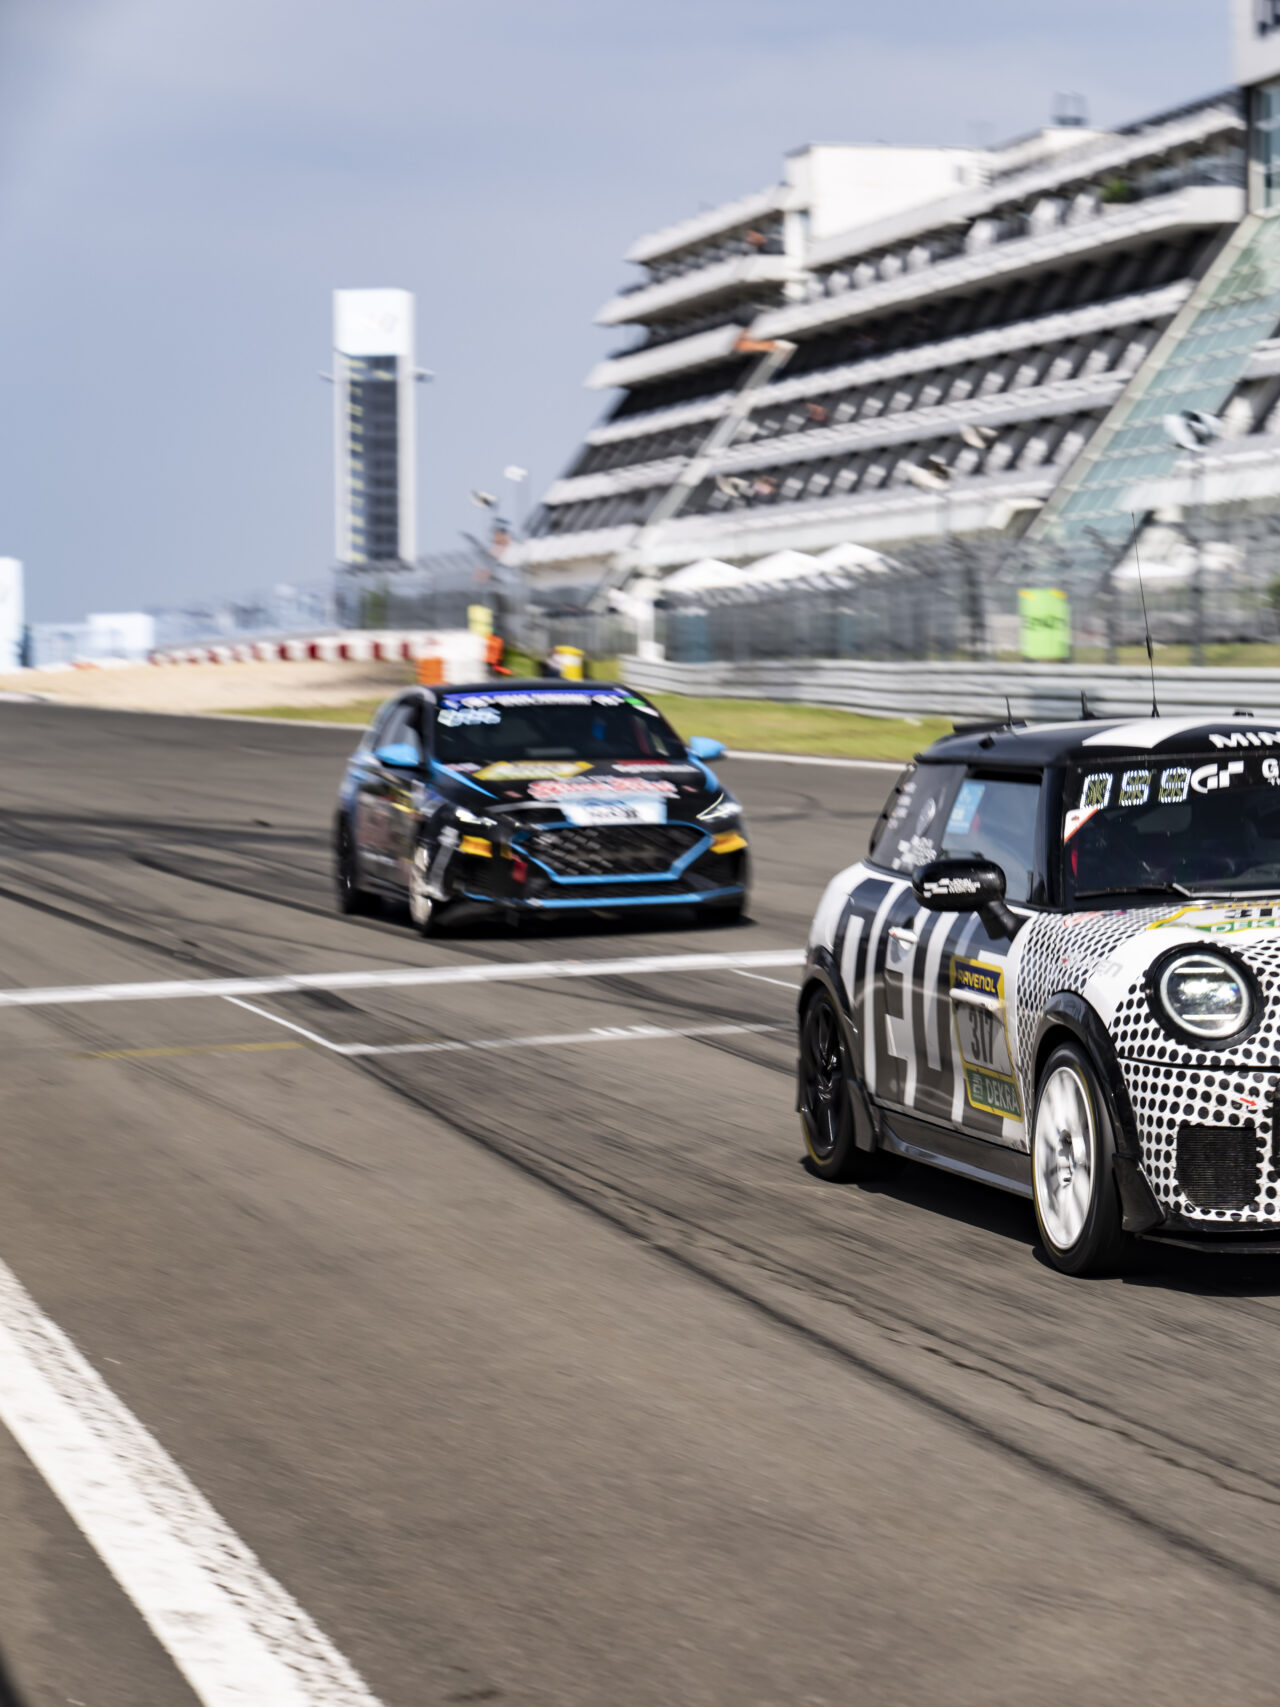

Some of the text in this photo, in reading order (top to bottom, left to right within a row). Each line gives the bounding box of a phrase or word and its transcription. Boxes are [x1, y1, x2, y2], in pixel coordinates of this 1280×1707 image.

[957, 968, 996, 994] RAVENOL
[969, 1007, 994, 1065] 317
[986, 1078, 1021, 1114] DEKRA
